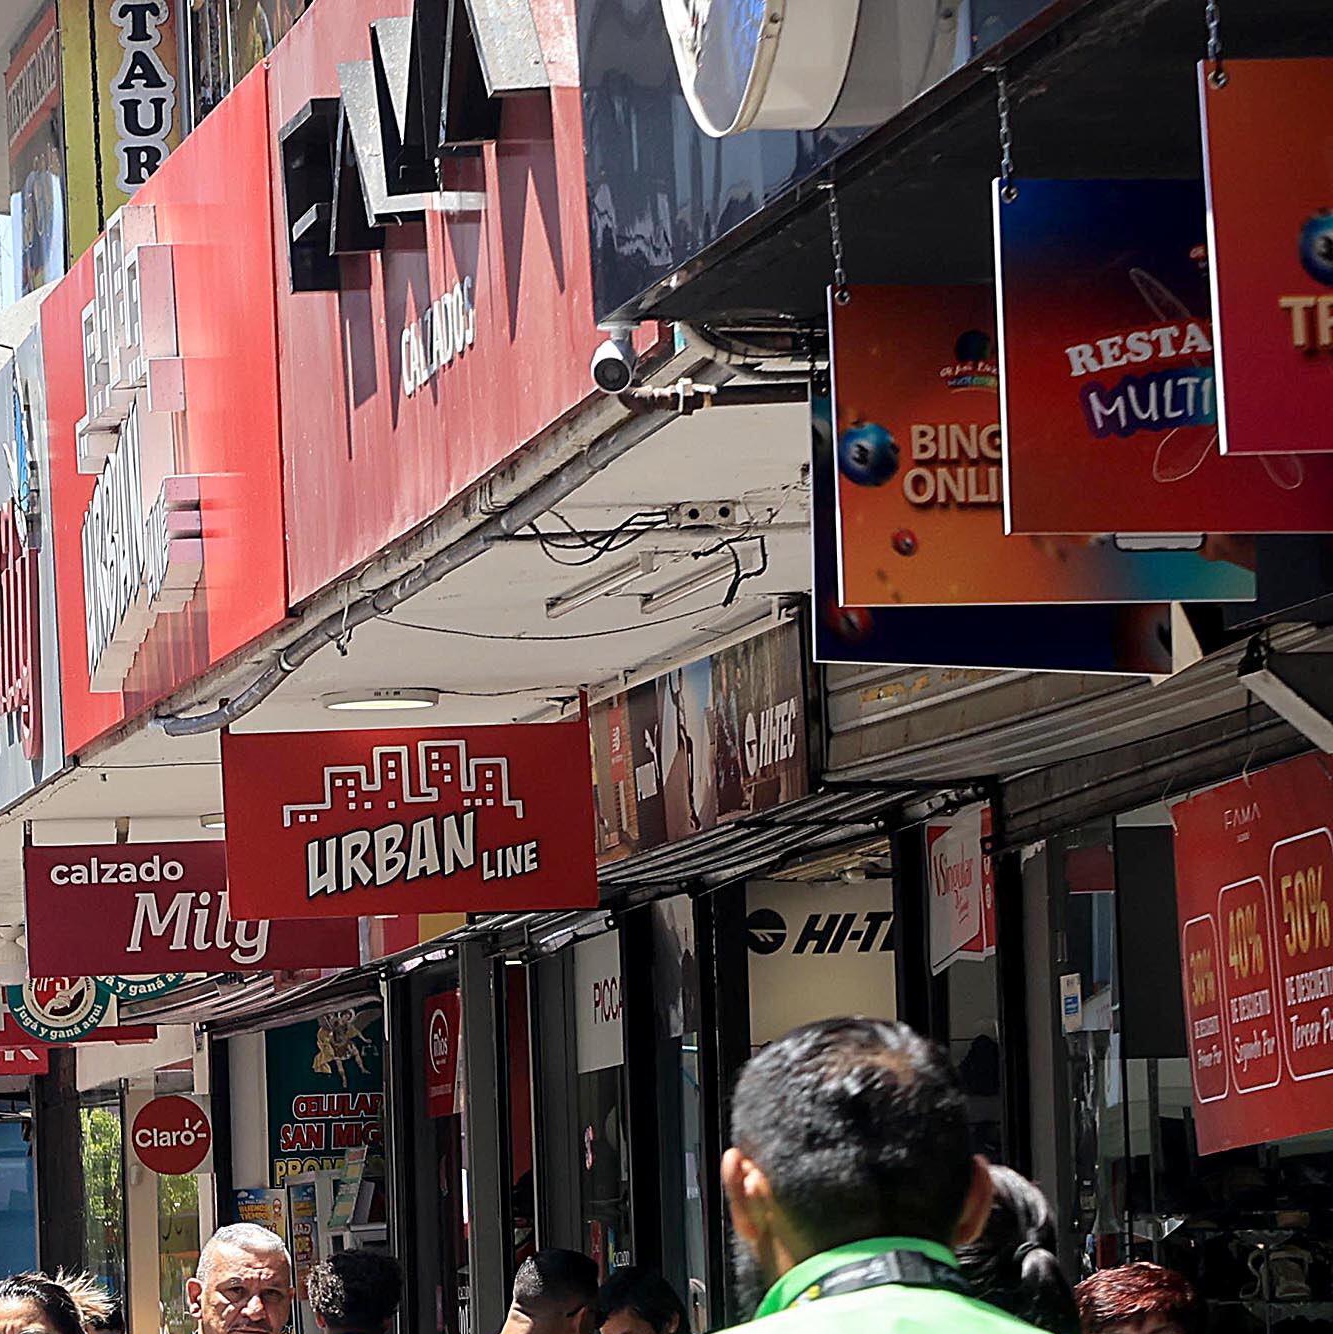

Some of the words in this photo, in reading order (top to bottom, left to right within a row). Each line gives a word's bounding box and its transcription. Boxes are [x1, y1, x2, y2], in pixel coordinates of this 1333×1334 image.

[401, 275, 476, 397] CALZADOS
[903, 467, 1002, 503] ONLI
[759, 697, 798, 769] HI-TEC
[50, 855, 184, 885] calzado
[307, 811, 475, 897] URBAN
[482, 841, 538, 881] LINE
[126, 890, 271, 965] Mily
[1280, 864, 1331, 957] 50%
[1228, 903, 1265, 981] 40%
[13, 1004, 38, 1032] Jugá
[49, 1024, 82, 1041] ganá
[1290, 1014, 1320, 1052] Tercer
[135, 1127, 196, 1148] Claro
[281, 1122, 325, 1151] SAN
